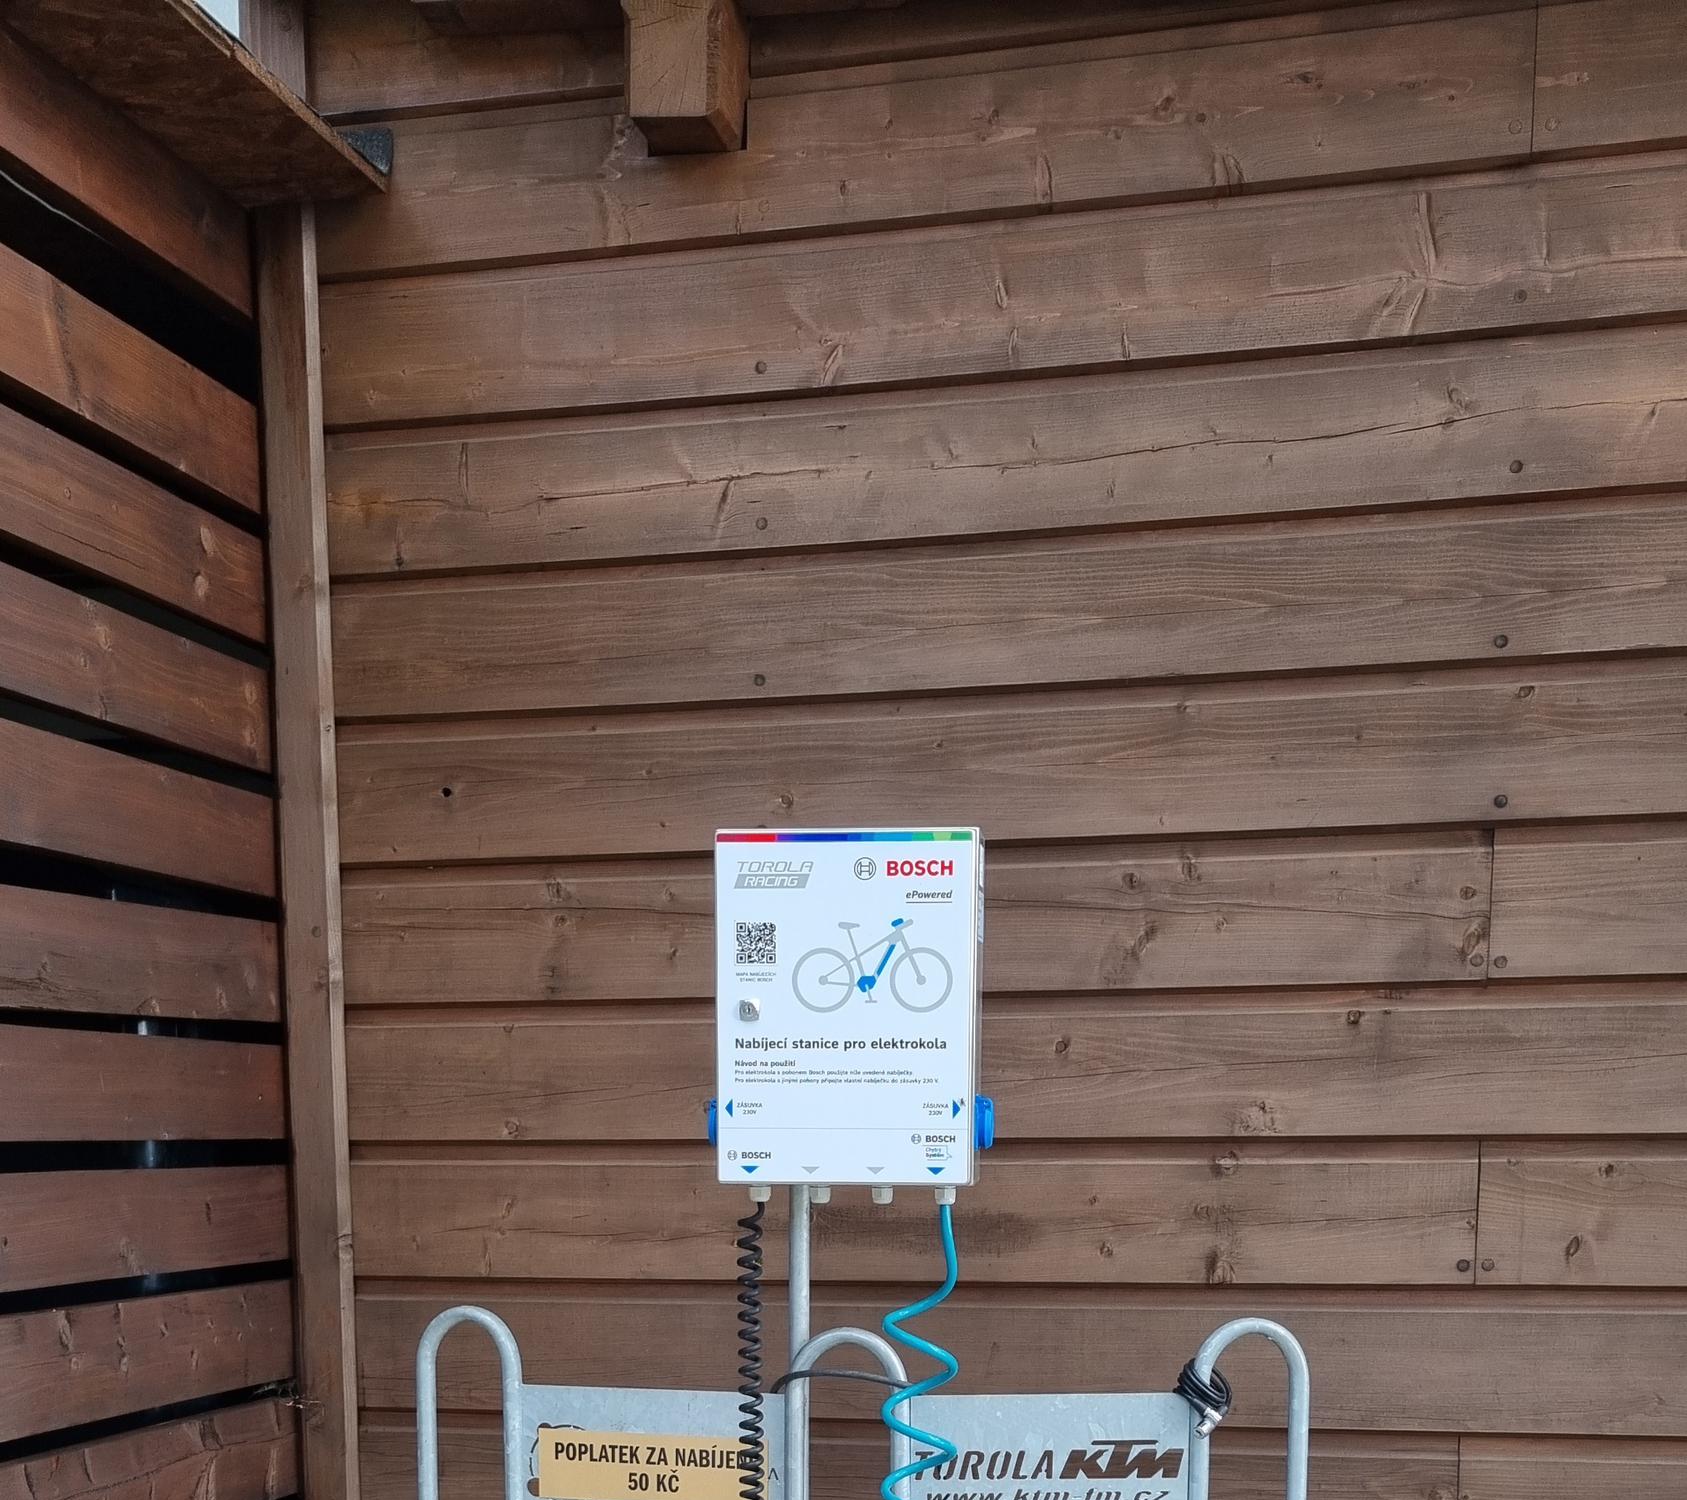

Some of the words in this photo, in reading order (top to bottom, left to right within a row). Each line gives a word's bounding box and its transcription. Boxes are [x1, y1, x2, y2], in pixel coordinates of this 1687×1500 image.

[737, 861, 814, 872] TOROLA
[886, 860, 953, 876] BOSCH
[744, 876, 800, 887] RACING
[905, 890, 953, 899] ePowered
[735, 1037, 788, 1052] Nabíjecí
[792, 1037, 839, 1049] stanice
[844, 1040, 867, 1052] pro
[871, 1037, 947, 1049] elektrokola
[770, 1060, 796, 1068] použití
[925, 1135, 956, 1143] BOSCH
[741, 1151, 772, 1159] BOSCH
[554, 1441, 640, 1465] POPLATEK
[646, 1446, 669, 1466] ZA
[913, 1449, 1054, 1481] TOROLA
[1059, 1439, 1185, 1479] KTM
[628, 1472, 650, 1492] 50
[656, 1469, 681, 1493] KČ
